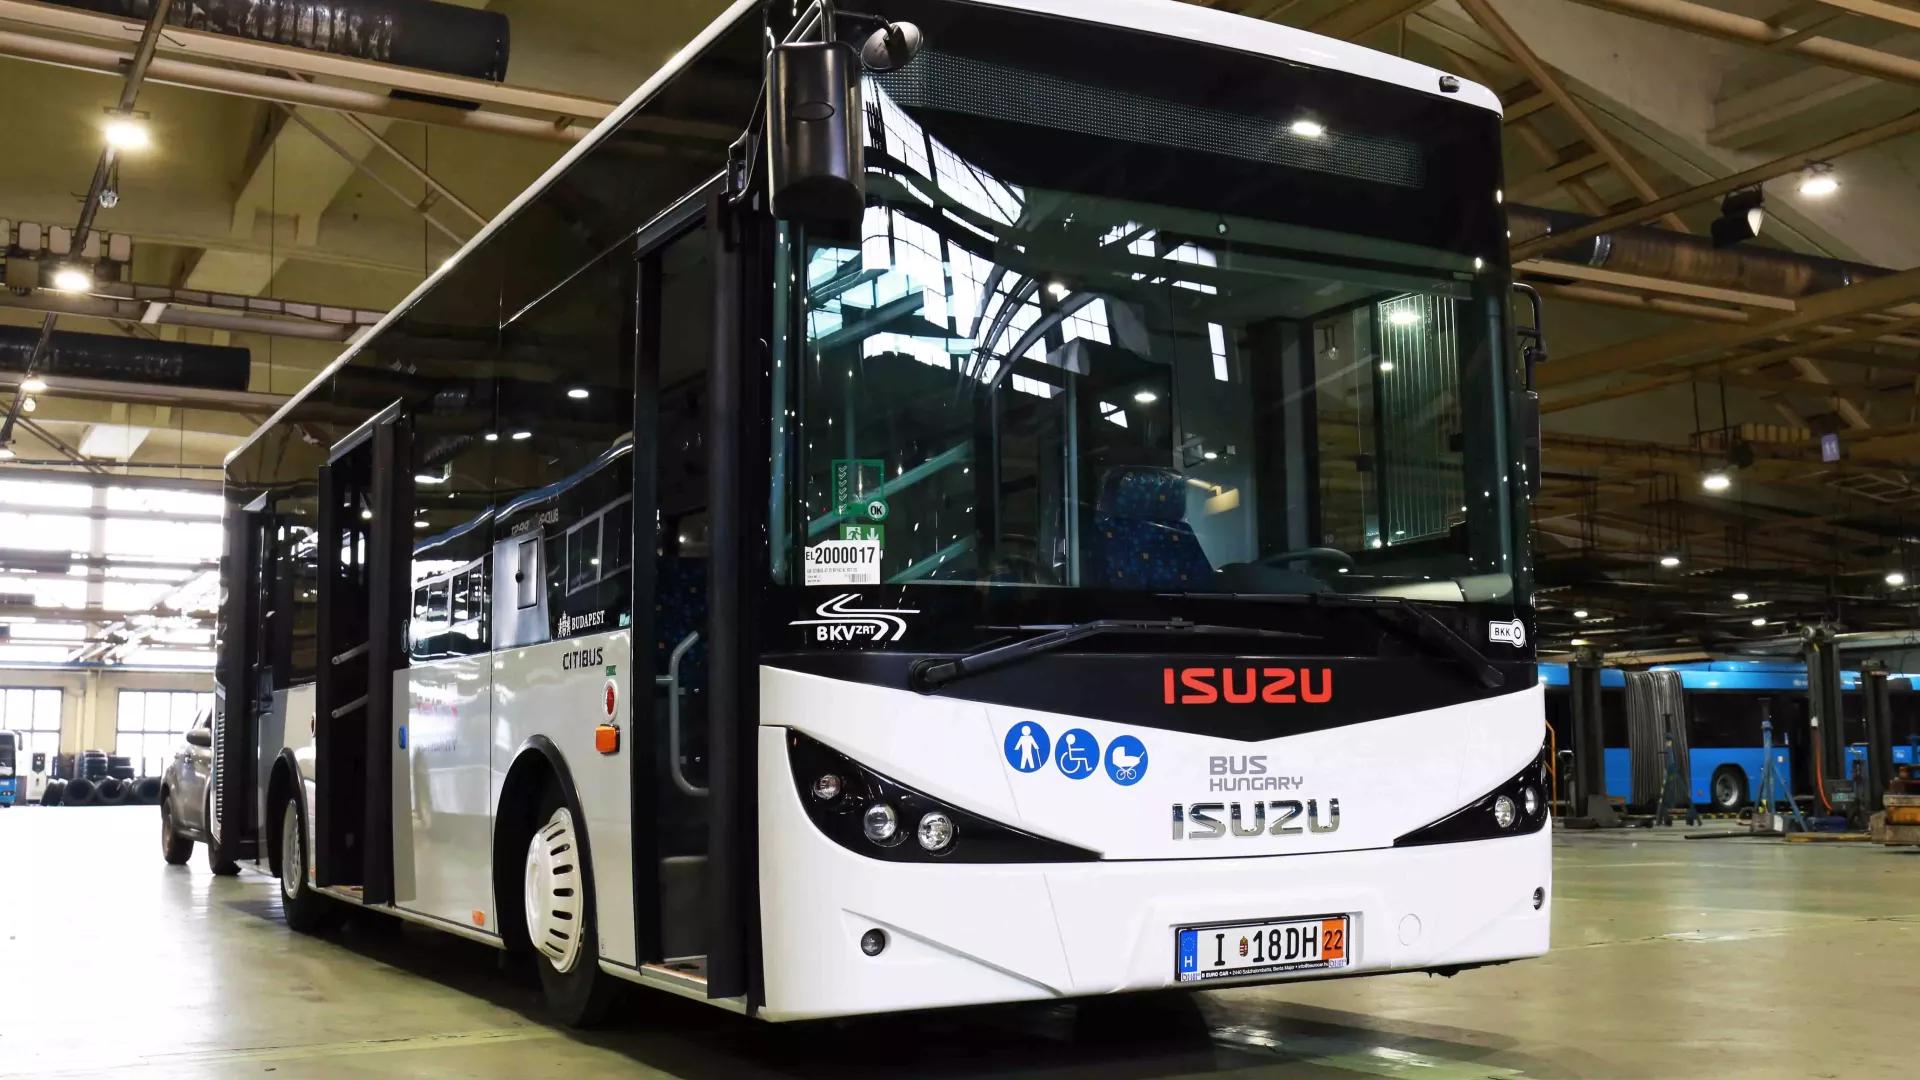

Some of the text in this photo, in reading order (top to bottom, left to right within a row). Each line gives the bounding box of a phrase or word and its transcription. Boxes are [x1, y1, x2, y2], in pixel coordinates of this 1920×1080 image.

[871, 506, 883, 516] OK
[805, 546, 876, 565] EL 2000017
[571, 610, 605, 630] BUDAPEST
[1494, 627, 1511, 636] BKK
[562, 647, 603, 670] CITIBUS
[1163, 667, 1333, 704] ISUZU
[1209, 755, 1267, 775] BUS
[1209, 776, 1304, 792] HUNGARY
[1171, 797, 1340, 840] ISUZU
[1214, 925, 1318, 967] I 18DH
[1323, 929, 1344, 951] 22
[1184, 955, 1193, 968] H
